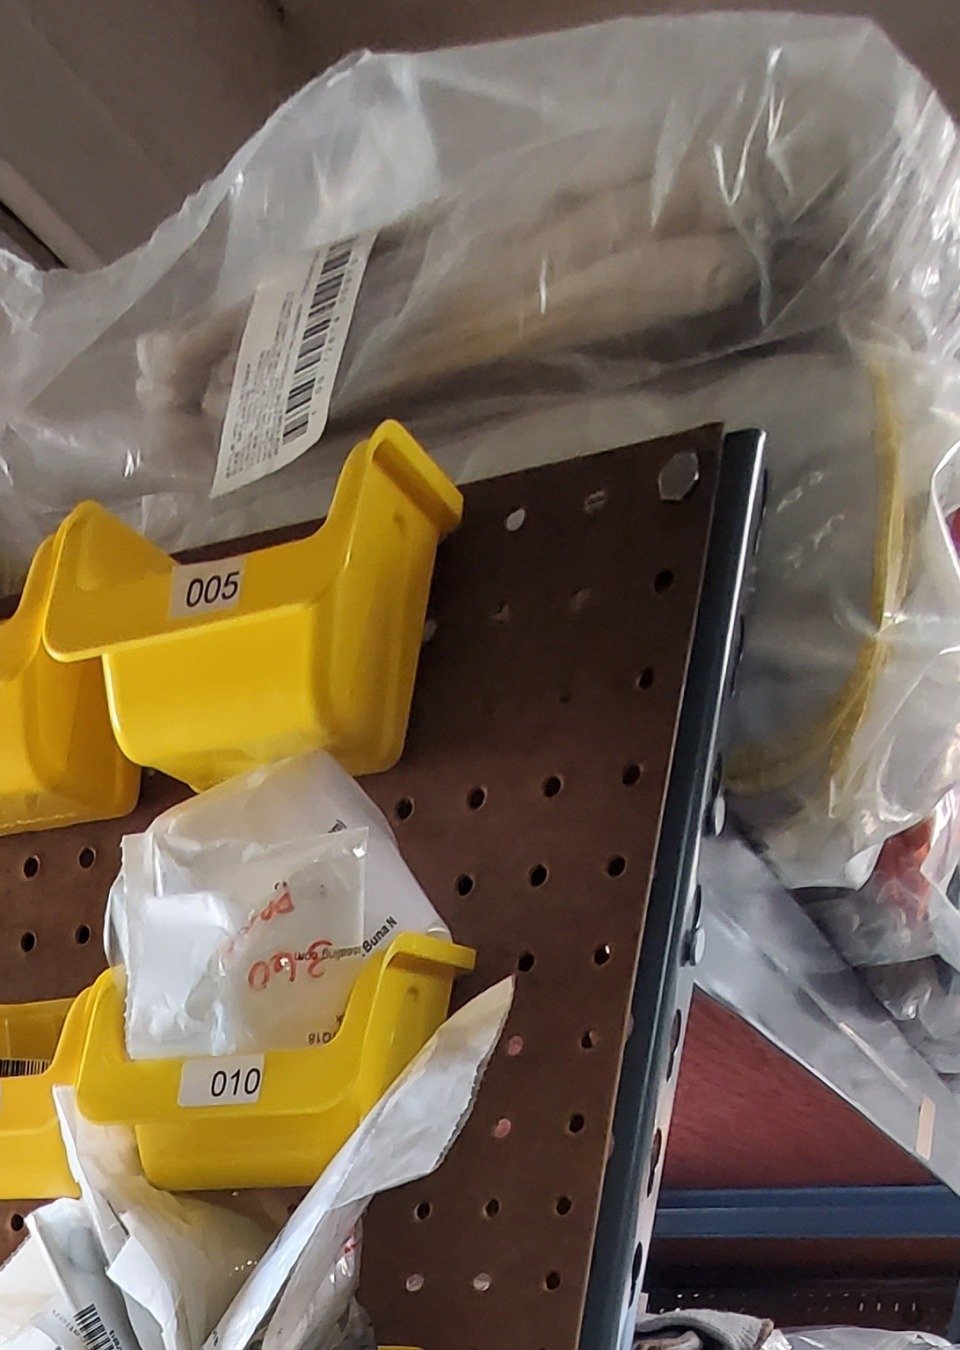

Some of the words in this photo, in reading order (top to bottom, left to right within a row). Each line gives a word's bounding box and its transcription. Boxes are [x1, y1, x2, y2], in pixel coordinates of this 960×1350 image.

[185, 571, 240, 608] 005
[361, 926, 390, 953] Buna
[386, 917, 399, 930] N
[210, 1068, 261, 1098] 010
